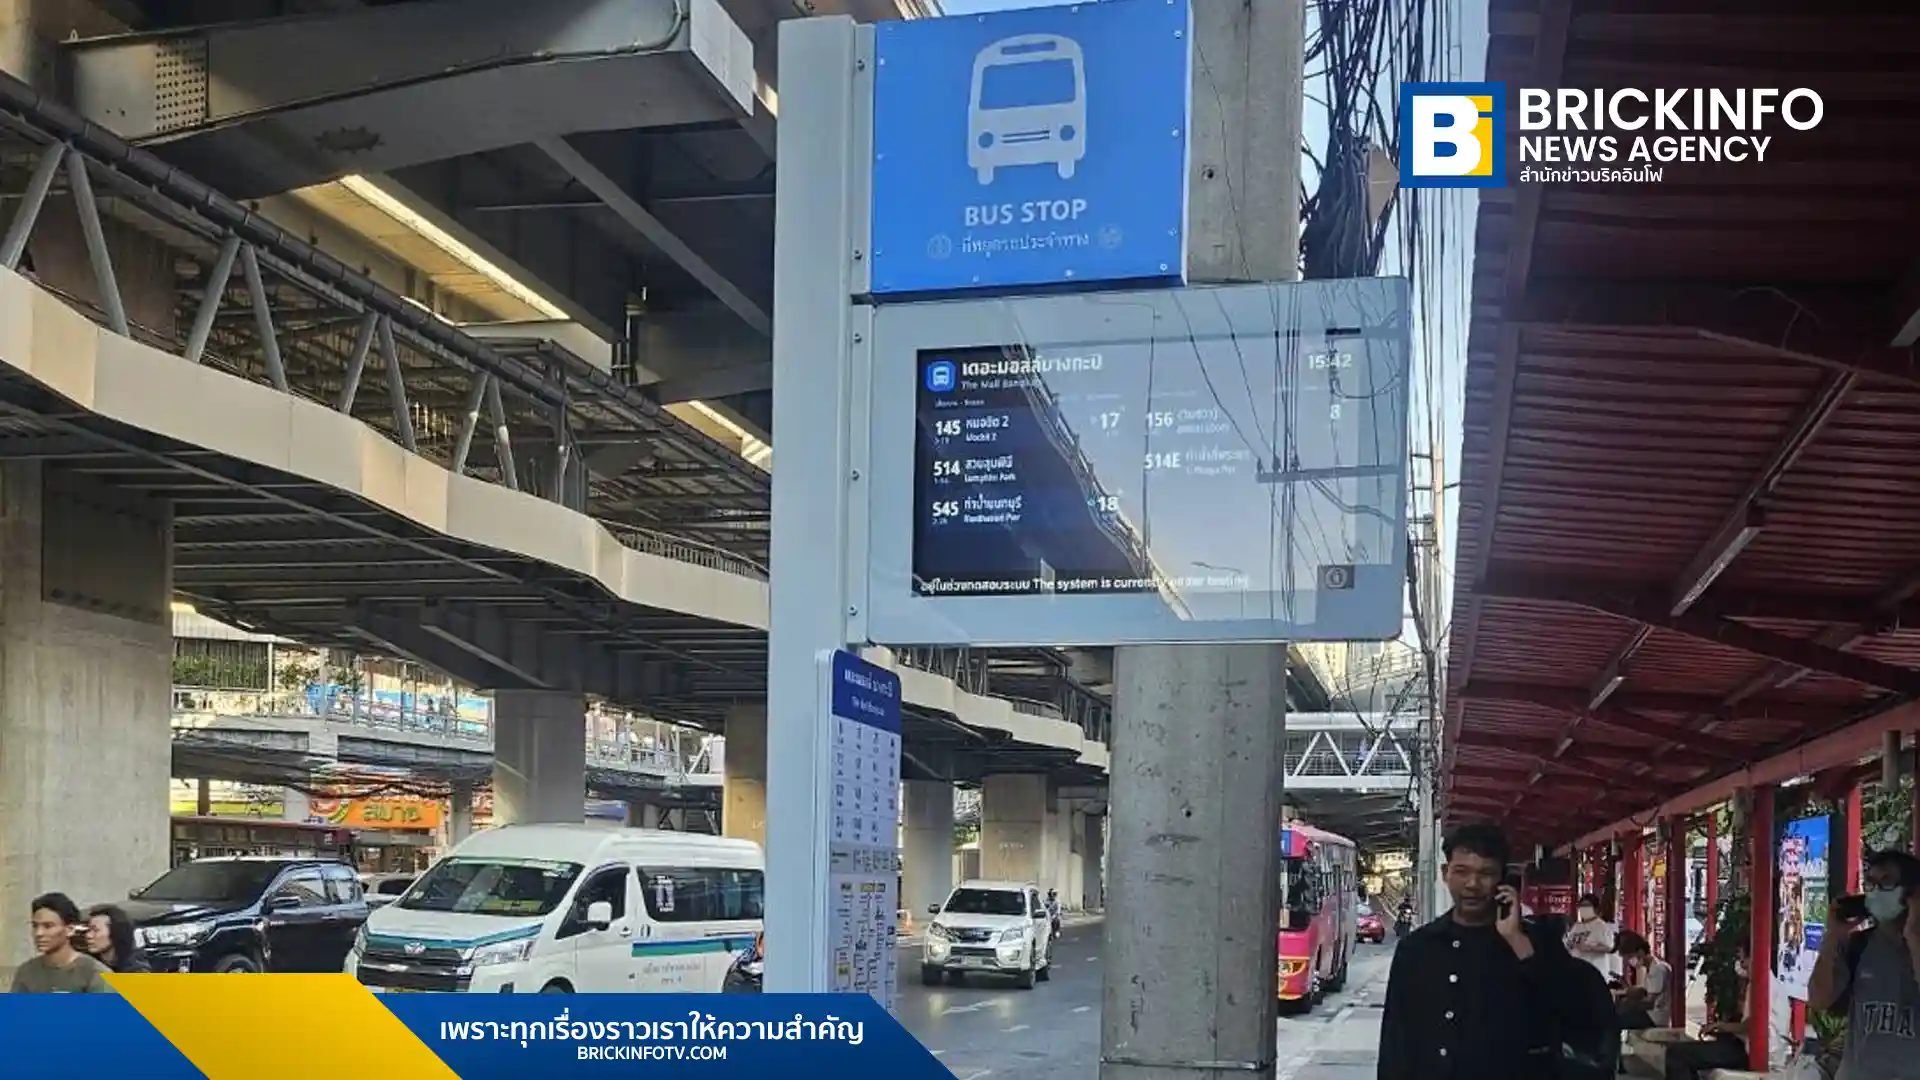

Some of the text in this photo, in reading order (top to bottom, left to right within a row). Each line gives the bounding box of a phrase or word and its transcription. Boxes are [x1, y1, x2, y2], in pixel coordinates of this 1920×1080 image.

[965, 199, 1088, 227] BUS STOP
[935, 419, 961, 436] 145
[1002, 415, 1010, 428] 2
[1100, 412, 1120, 430] 17
[1146, 411, 1174, 428] 156
[933, 459, 961, 476] 514
[1144, 451, 1181, 469] 514E
[932, 500, 959, 517] 545
[1099, 496, 1119, 513] 18
[1032, 577, 1055, 590] The
[1057, 576, 1098, 592] system
[1101, 575, 1111, 588] is
